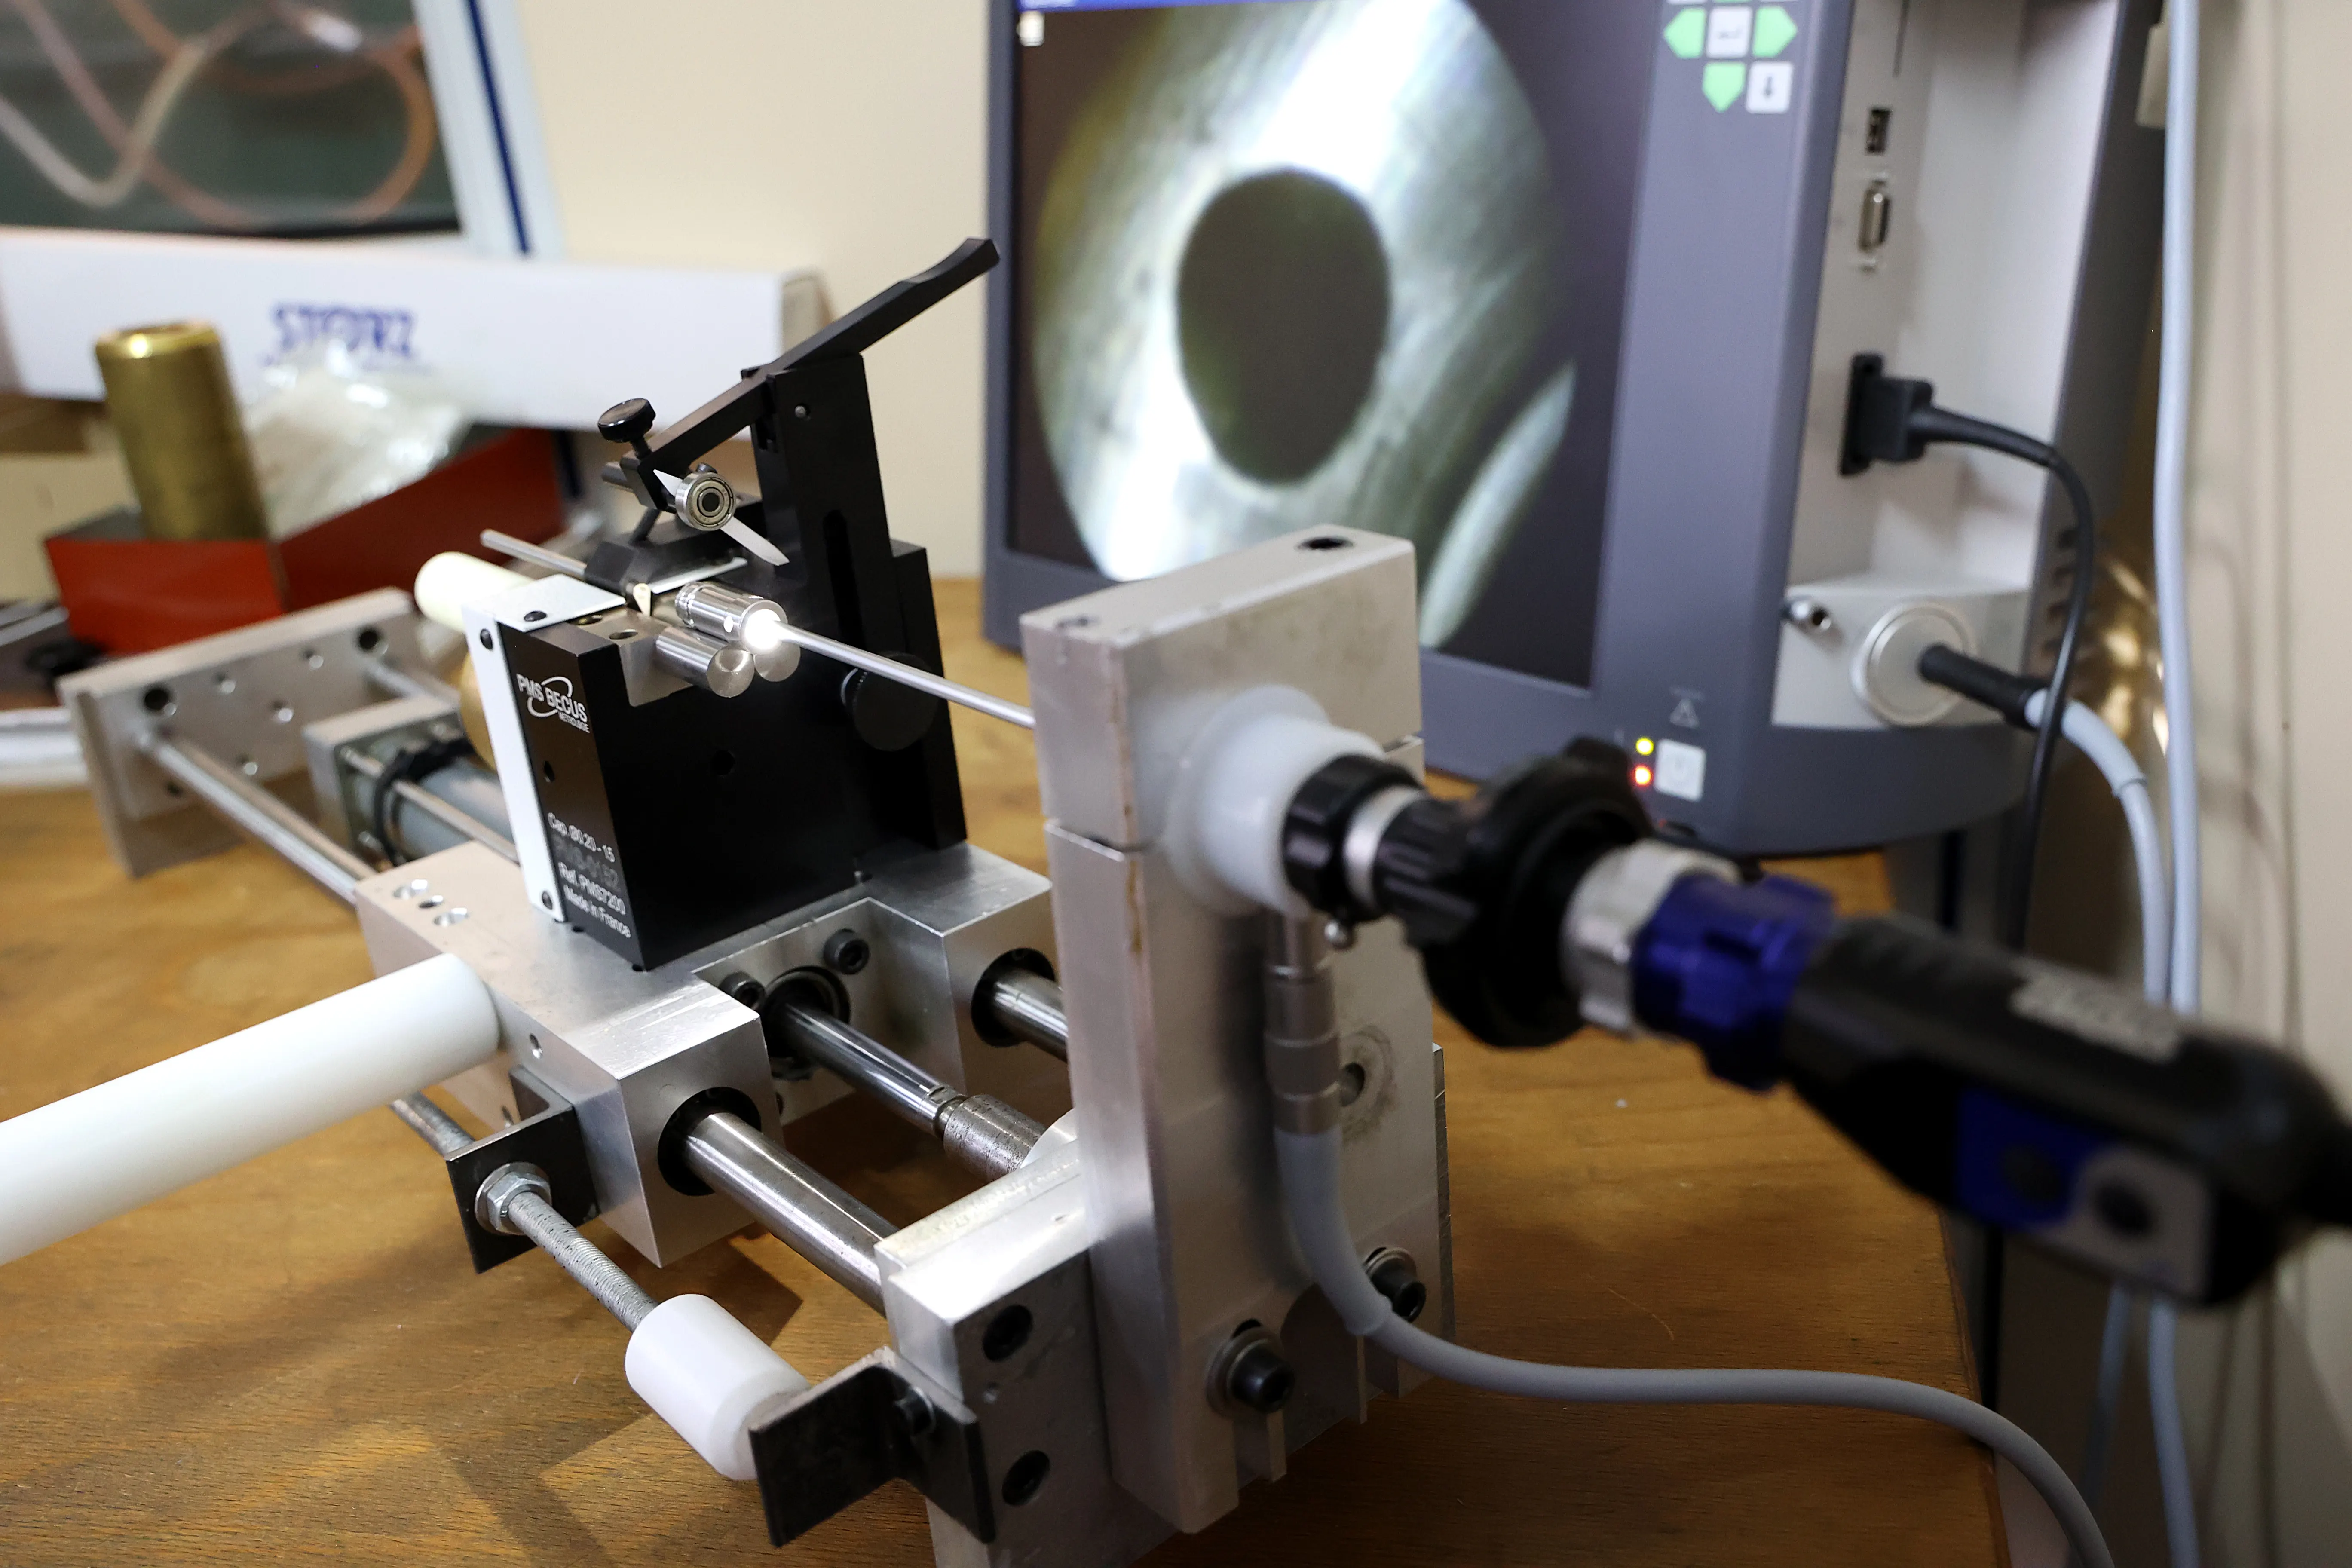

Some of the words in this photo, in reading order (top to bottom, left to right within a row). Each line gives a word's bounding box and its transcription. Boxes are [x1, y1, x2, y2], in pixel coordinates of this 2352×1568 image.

[516, 673, 545, 702] PMS
[545, 687, 588, 723] BECUS
[602, 844, 616, 863] 15
[563, 885, 589, 913] Made
[597, 906, 631, 938] France
